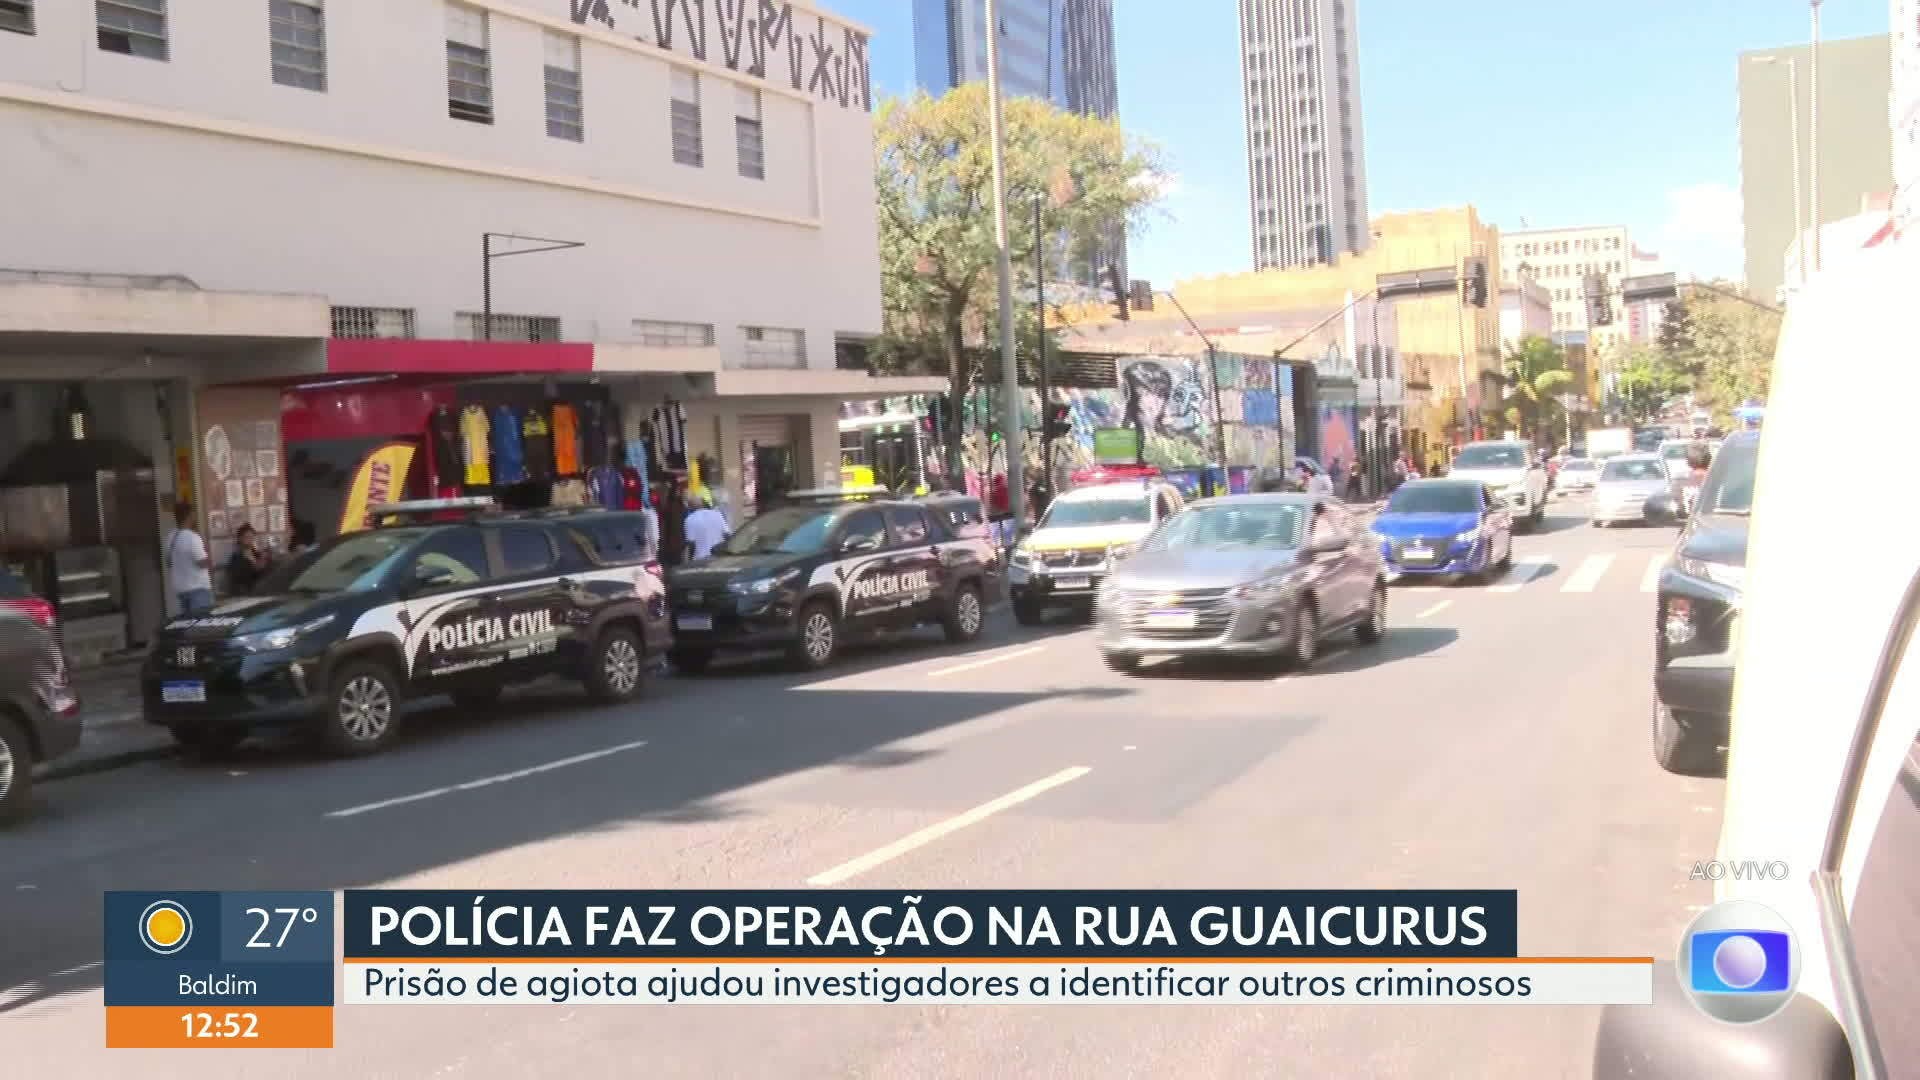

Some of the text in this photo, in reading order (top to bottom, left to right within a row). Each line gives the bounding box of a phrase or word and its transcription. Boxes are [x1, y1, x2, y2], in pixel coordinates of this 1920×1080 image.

[854, 573, 900, 600] POLÍCIA
[901, 569, 929, 592] CIVIL
[428, 614, 505, 653] POLÍCIA
[508, 608, 555, 639] CIVIL
